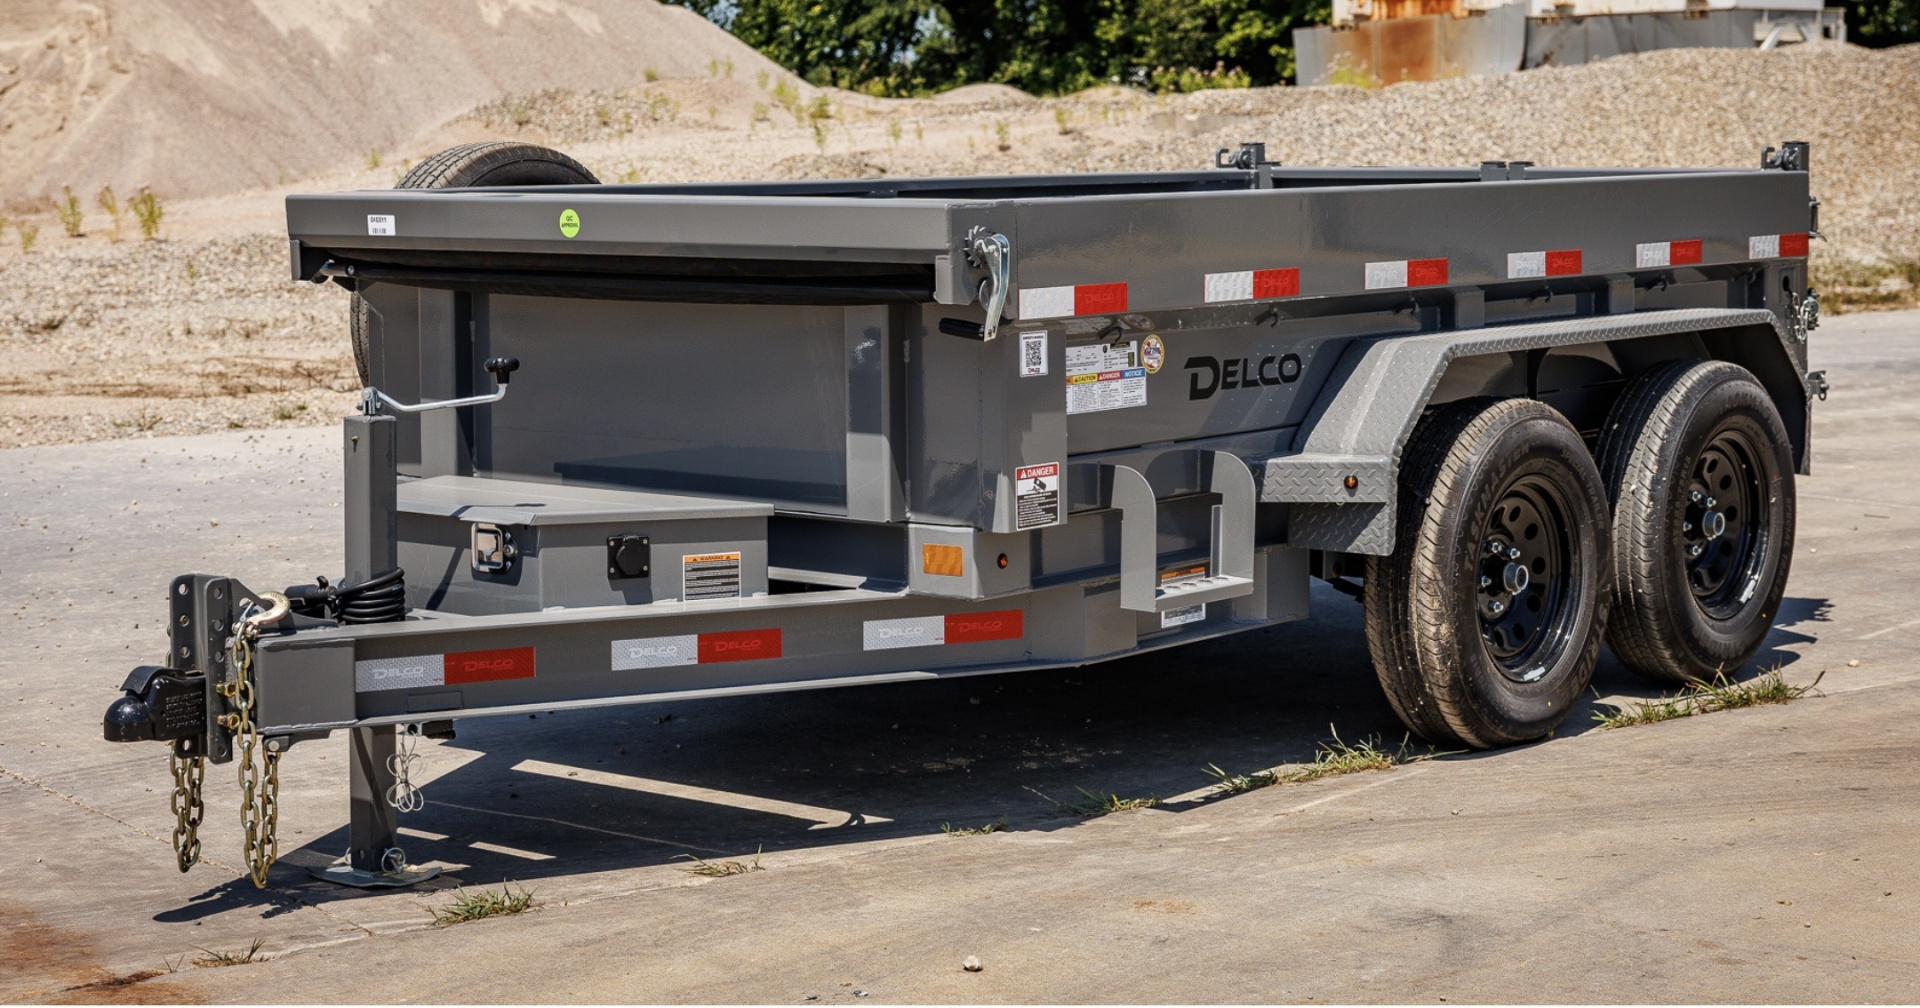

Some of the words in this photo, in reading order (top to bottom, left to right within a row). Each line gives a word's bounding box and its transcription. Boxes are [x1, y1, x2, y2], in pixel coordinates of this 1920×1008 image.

[1263, 277, 1290, 288] DELCO
[1084, 292, 1115, 304] DELCO
[1078, 375, 1096, 383] CAUTION
[1101, 371, 1121, 380] DANGER
[1183, 352, 1302, 401] DELCO
[1027, 466, 1054, 477] DANGER
[1561, 449, 1587, 481] SPECIAL
[1586, 481, 1605, 529] TRAILER
[1464, 438, 1531, 571] TASKMASTER
[878, 626, 924, 639] DELCO
[957, 621, 1002, 633] DELCO
[628, 645, 678, 659] DELCO
[713, 639, 761, 652] DELCO
[463, 658, 513, 672] DELCO
[372, 666, 424, 680] DELCO
